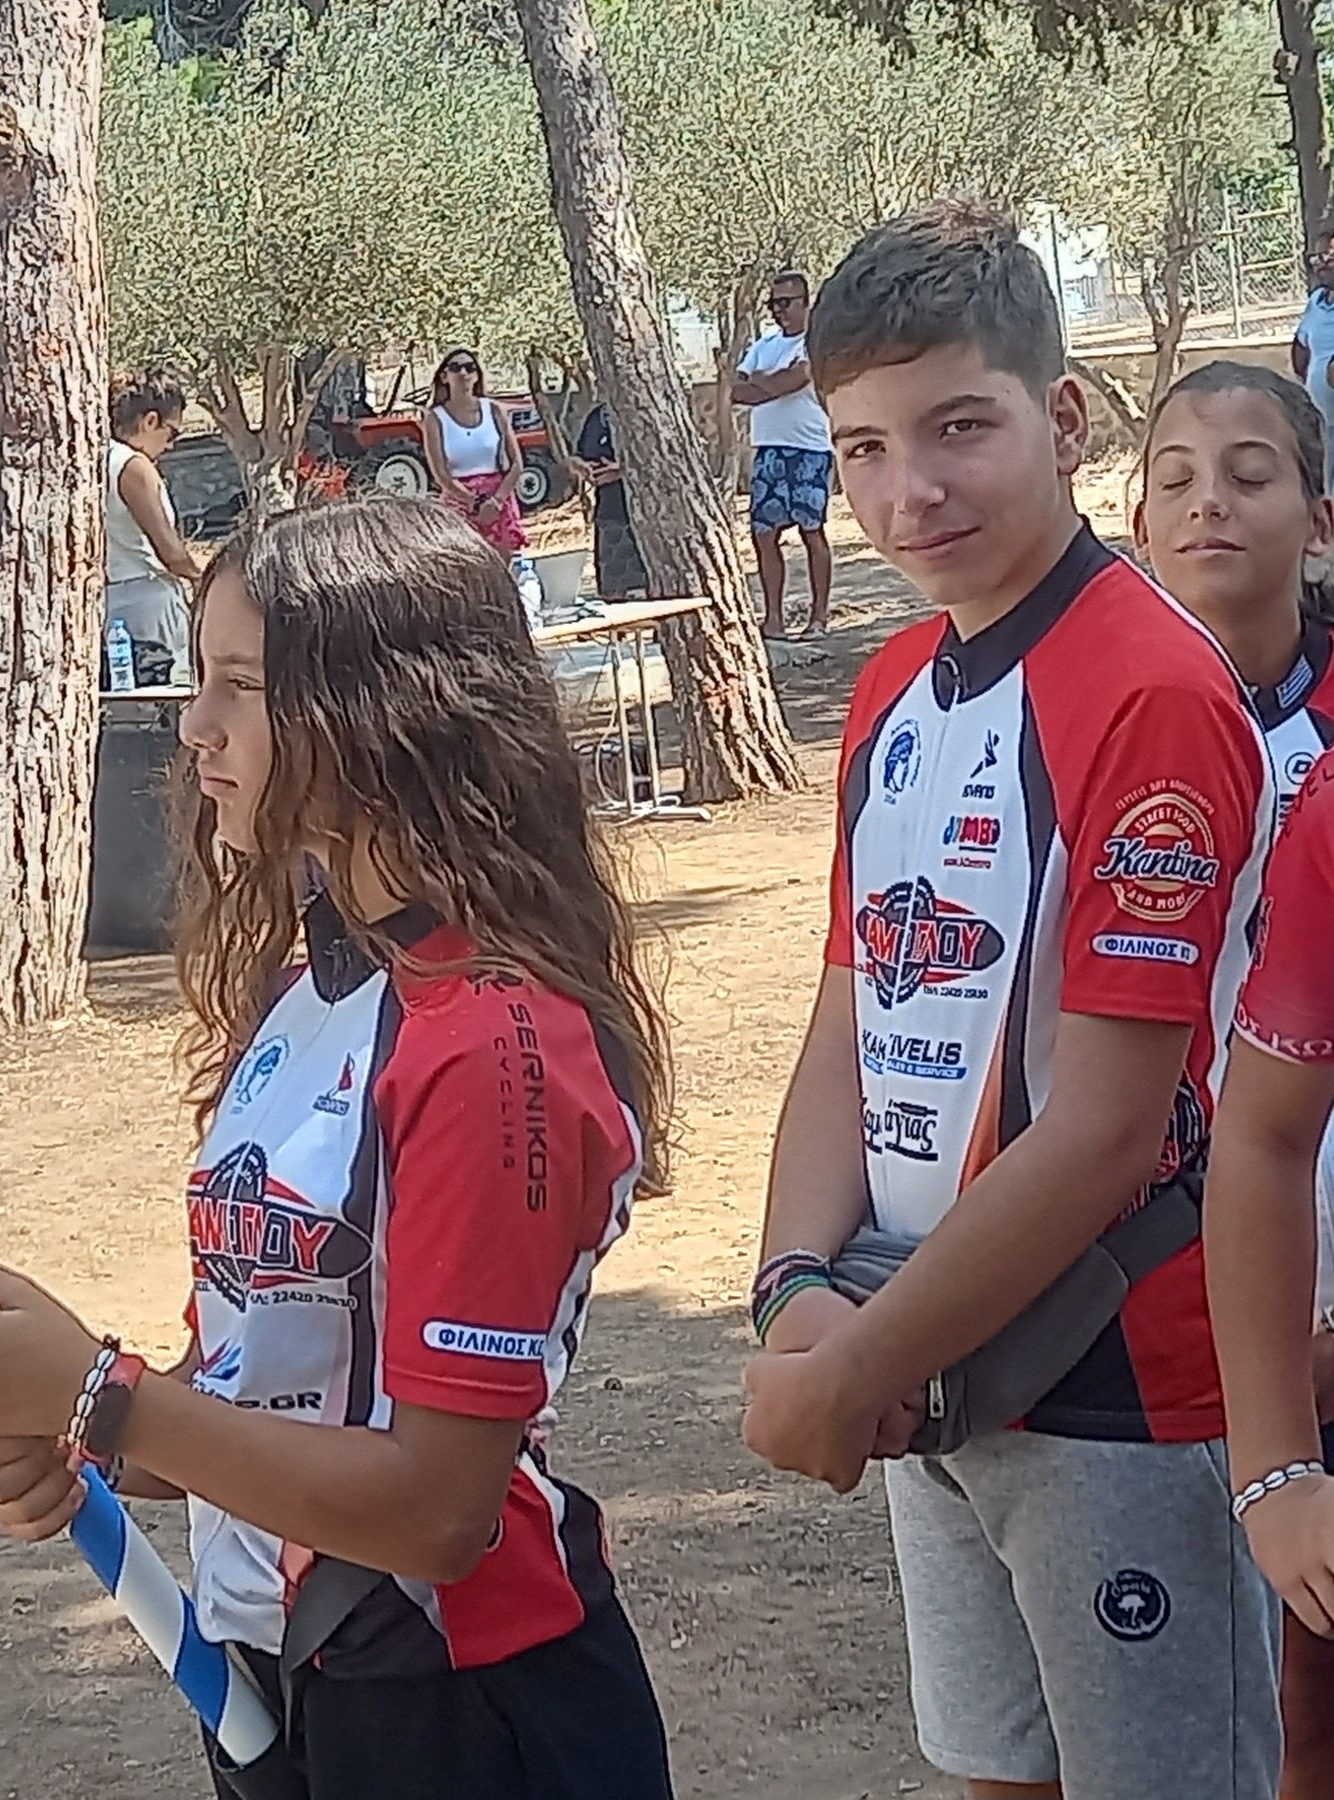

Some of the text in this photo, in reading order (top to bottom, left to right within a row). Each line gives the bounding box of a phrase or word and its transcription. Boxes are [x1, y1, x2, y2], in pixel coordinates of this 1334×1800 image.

[1095, 838, 1220, 887] Kantina
[1104, 937, 1179, 958] ΦΙΛΙΝΟΣ
[492, 1035, 517, 1170] CYCLING
[507, 1002, 548, 1213] SERNIKOS
[437, 1328, 528, 1356] ΦΙΛΙΝΟΣ
